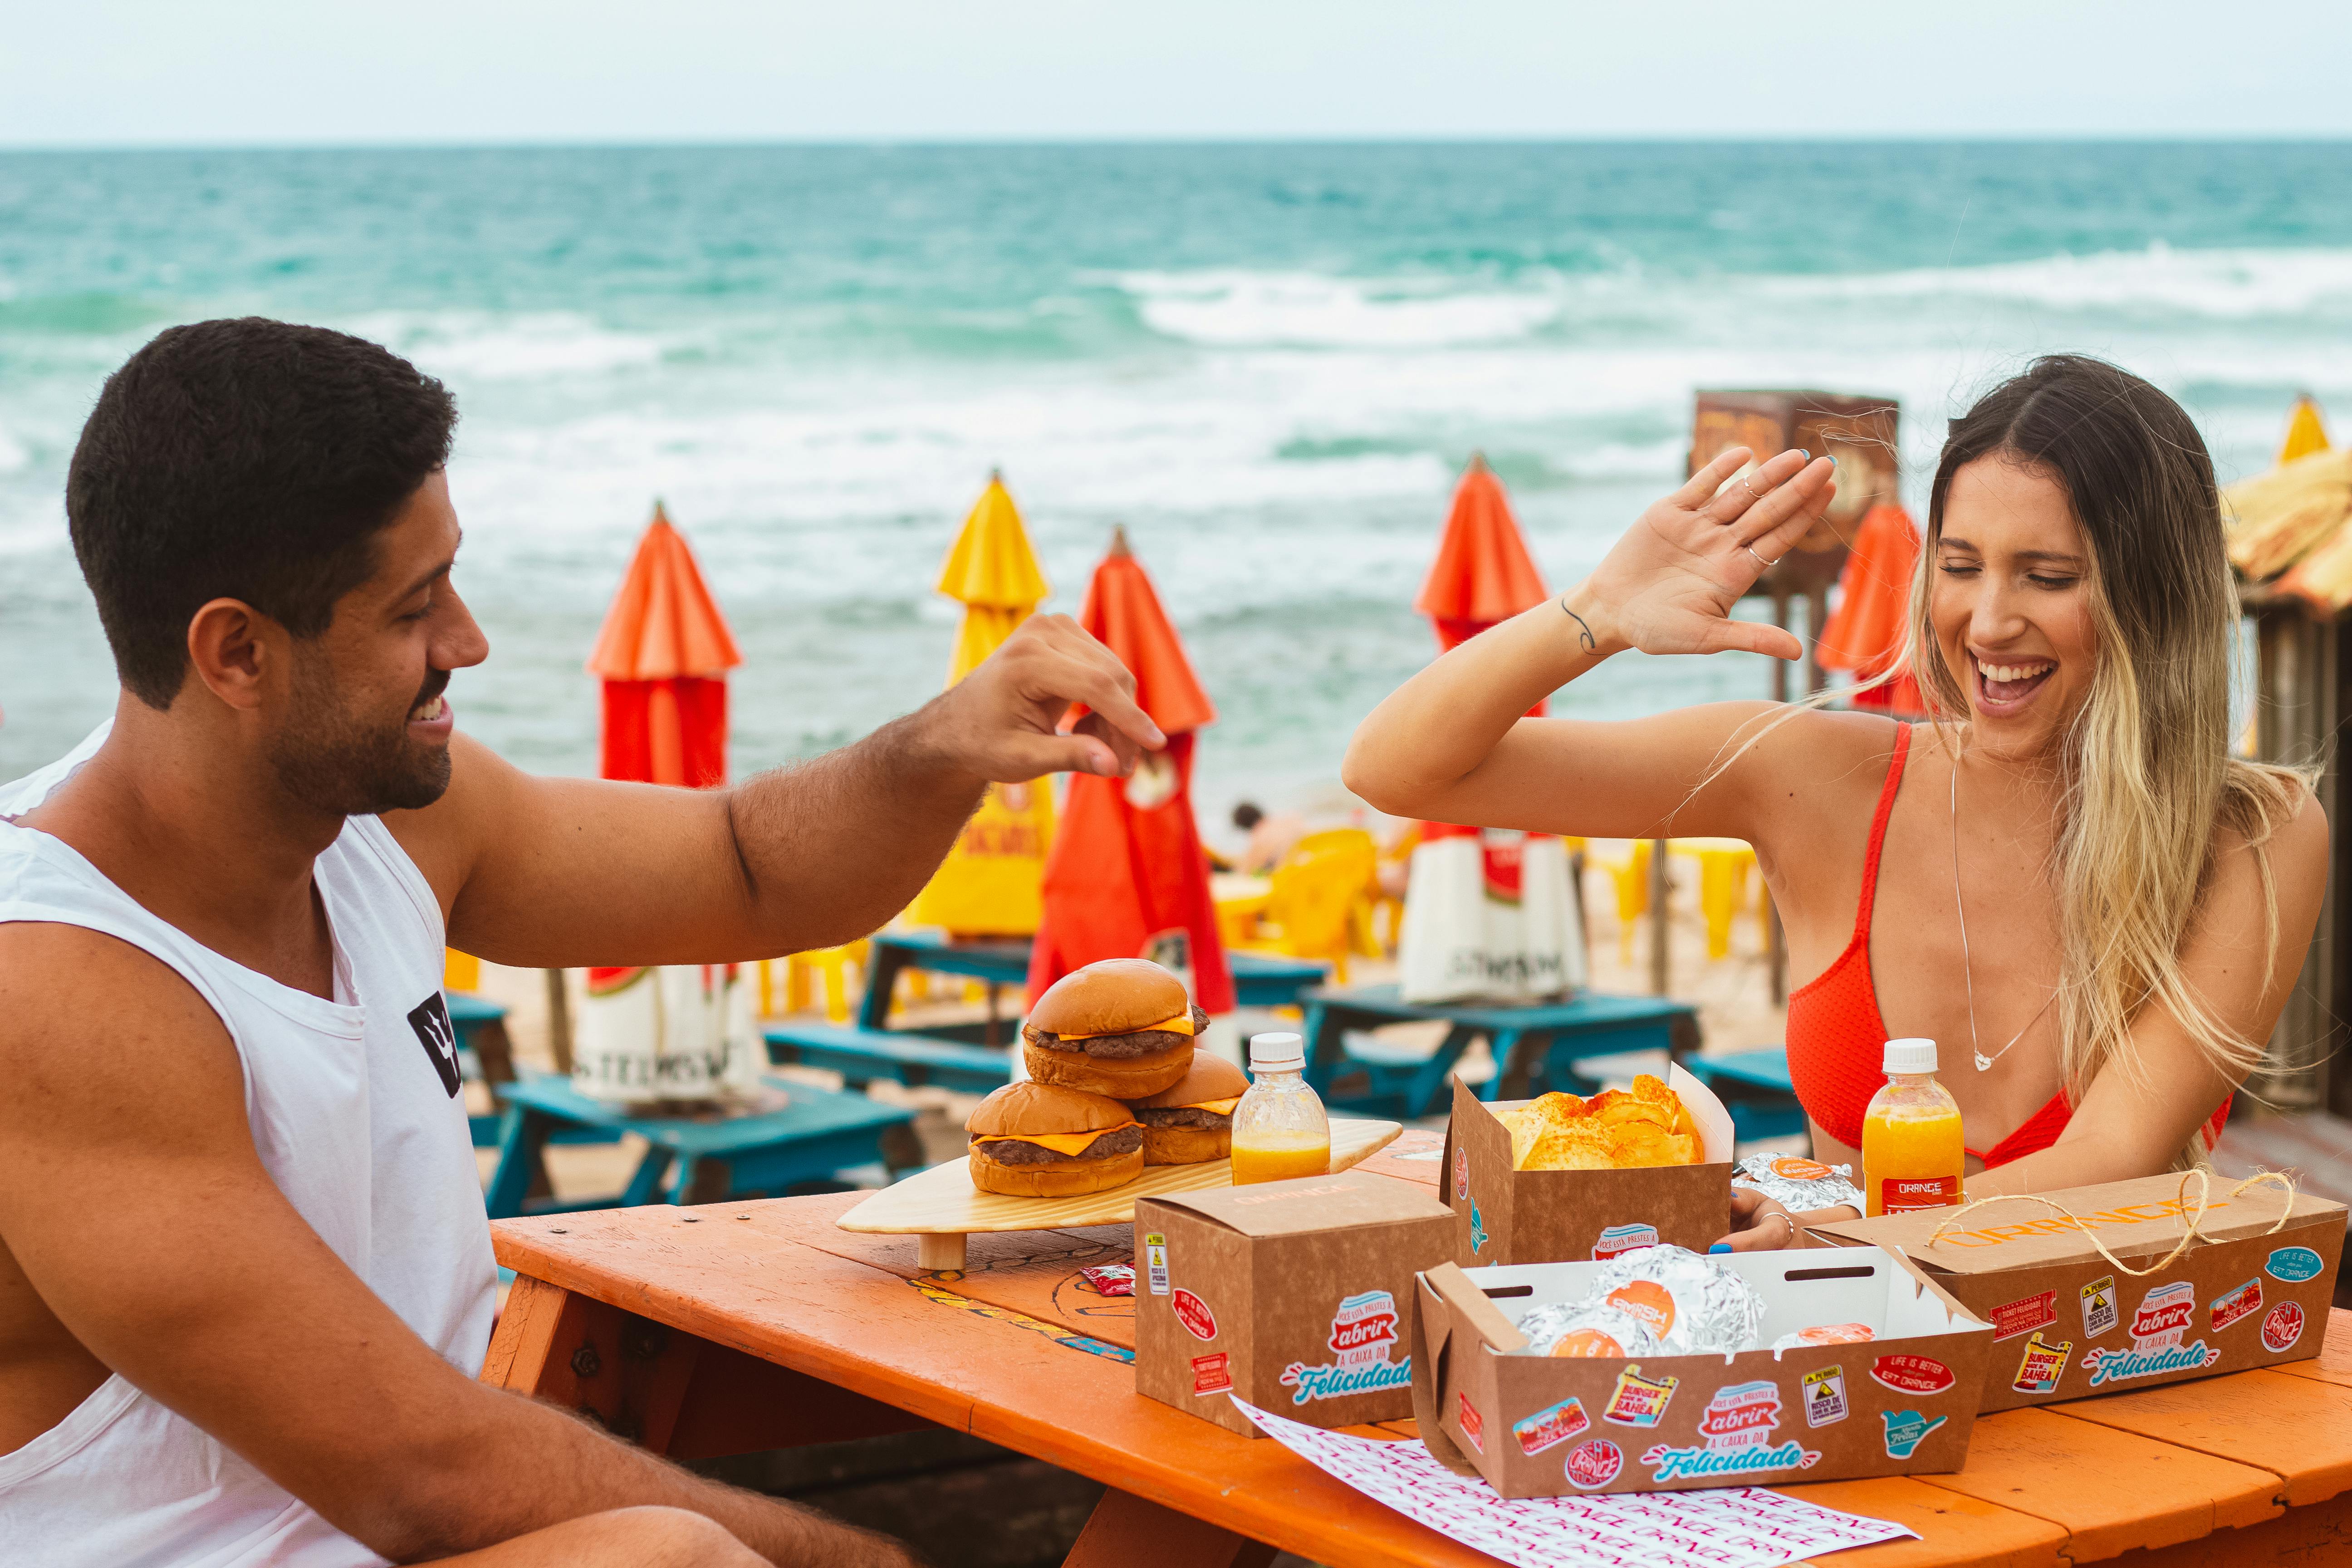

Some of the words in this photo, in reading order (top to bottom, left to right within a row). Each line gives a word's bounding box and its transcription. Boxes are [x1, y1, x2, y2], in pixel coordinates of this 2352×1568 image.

[1899, 1182, 1942, 1193] ORANGE
[1939, 1196, 2230, 1248] ORANGE
[1599, 1240, 1612, 1249] VOCÊ
[1627, 1235, 1649, 1244] PRESTES
[2091, 1279, 2110, 1293] PERIGO
[1613, 1298, 1667, 1324] SMASH
[2143, 1300, 2154, 1310] VOCÊ
[2167, 1292, 2186, 1303] PRESTES
[2088, 1309, 2104, 1322] RISCO
[2105, 1305, 2113, 1314] DE
[2139, 1308, 2185, 1333] abrir
[2277, 1303, 2300, 1323] EAT
[1338, 1318, 1388, 1347] abrir
[2266, 1310, 2301, 1341] ORANGE
[2136, 1340, 2142, 1352] A
[2145, 1335, 2166, 1349] CAIXA
[2170, 1333, 2179, 1344] DA
[1339, 1355, 1345, 1367] A
[1349, 1349, 1372, 1365] CAIXA
[1375, 1346, 1387, 1359] DA
[1890, 1356, 1906, 1366] LIFE
[1908, 1357, 1918, 1367] IS
[1918, 1359, 1944, 1375] BETTER
[2028, 1353, 2058, 1365] BURGER
[2092, 1343, 2208, 1384] Felicidade
[1295, 1358, 1411, 1402] Felicidad
[1900, 1376, 1938, 1389] ORANGE
[1711, 1406, 1768, 1431] abrir
[1710, 1437, 1716, 1450] A
[1721, 1433, 1748, 1447] CAIXA
[1752, 1431, 1764, 1443] DA
[1569, 1449, 1618, 1477] ORANGE
[1656, 1444, 1803, 1480] Felicidade
